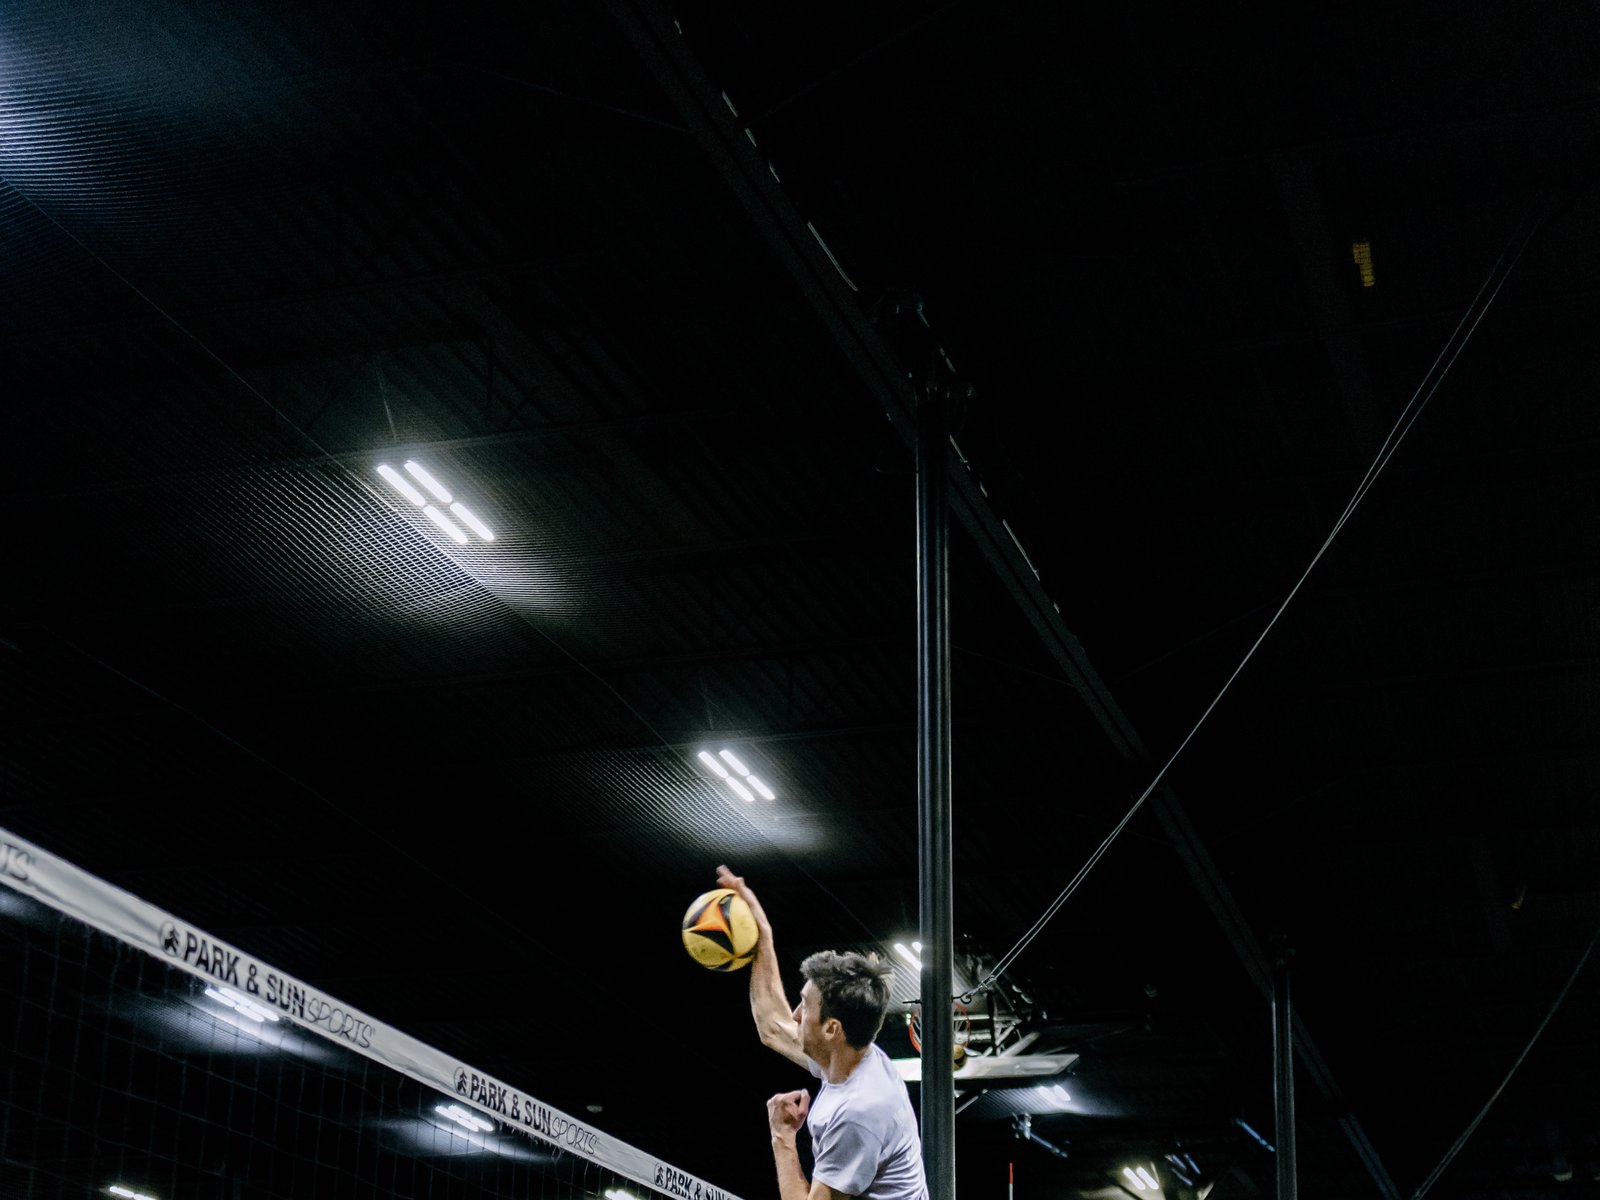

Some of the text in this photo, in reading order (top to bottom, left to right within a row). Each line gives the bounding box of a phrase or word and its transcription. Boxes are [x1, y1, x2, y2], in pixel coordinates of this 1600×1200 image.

[184, 931, 241, 988] PARK
[246, 963, 259, 996] &
[470, 1073, 507, 1116] PARK
[511, 1094, 520, 1120] &
[665, 1167, 693, 1200] PARK
